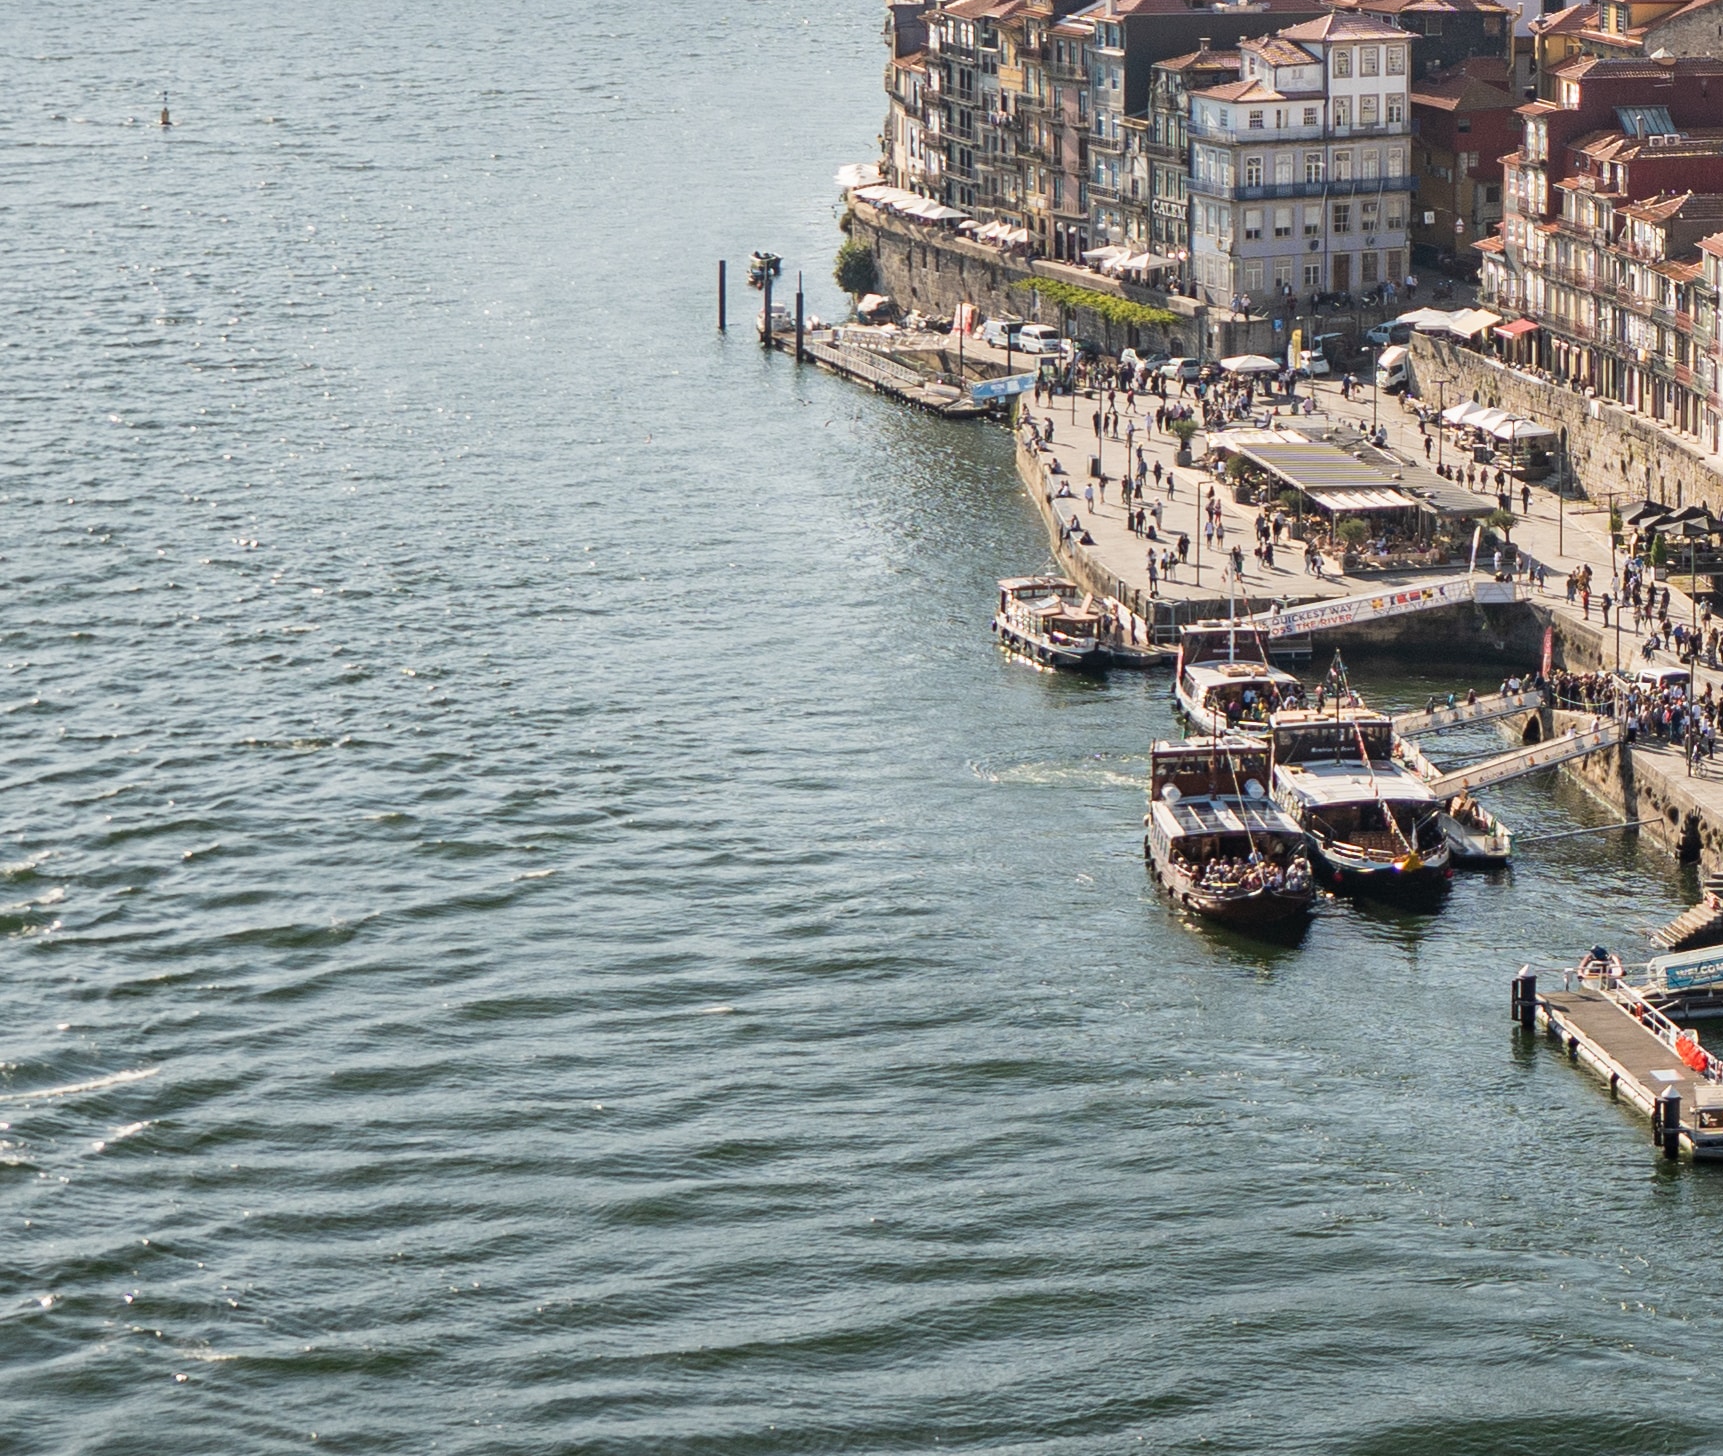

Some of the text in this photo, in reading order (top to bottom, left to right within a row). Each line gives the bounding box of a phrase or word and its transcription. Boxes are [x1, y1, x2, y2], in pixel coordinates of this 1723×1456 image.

[1330, 604, 1353, 615] WAY
[1295, 620, 1317, 631] THE
[1320, 614, 1353, 626] RIVER
